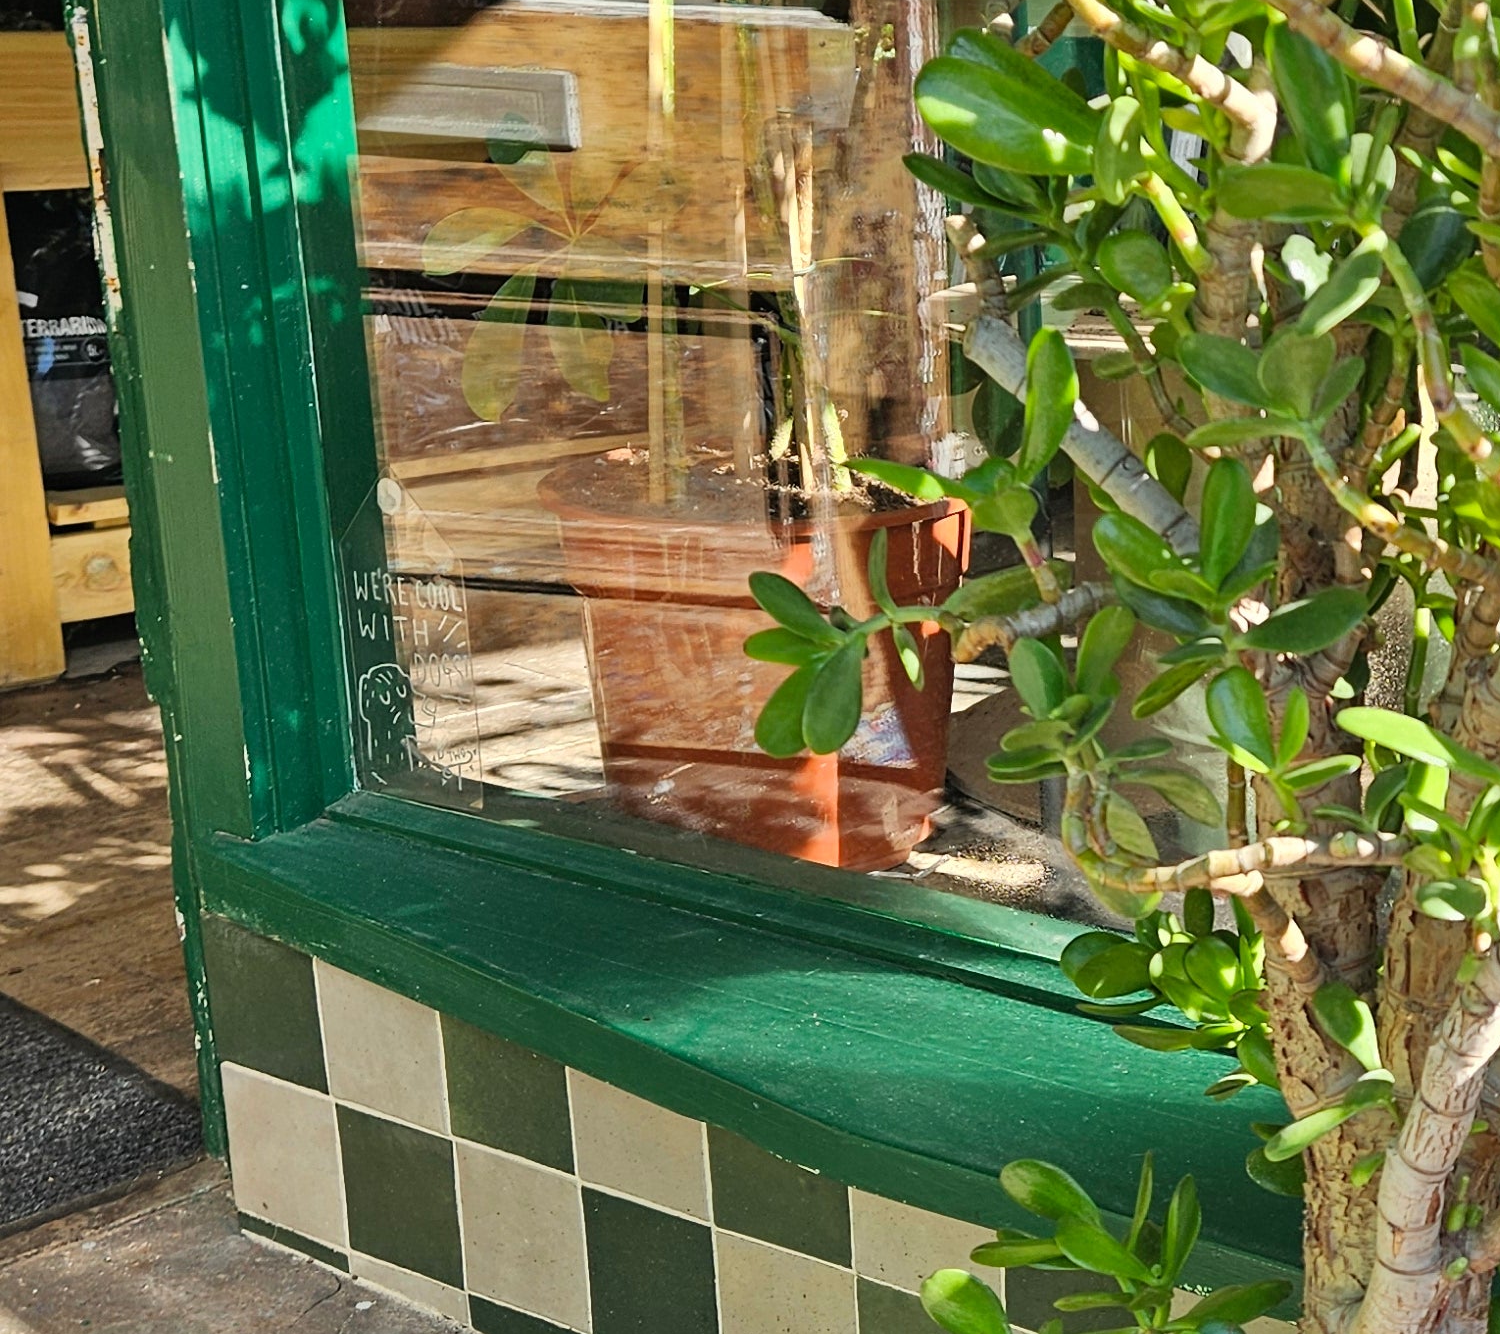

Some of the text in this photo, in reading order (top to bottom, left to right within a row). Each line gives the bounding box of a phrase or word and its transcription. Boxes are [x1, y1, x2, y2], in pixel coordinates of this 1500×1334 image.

[353, 568, 462, 612] WE'RE COOL
[358, 609, 429, 647] WITH
